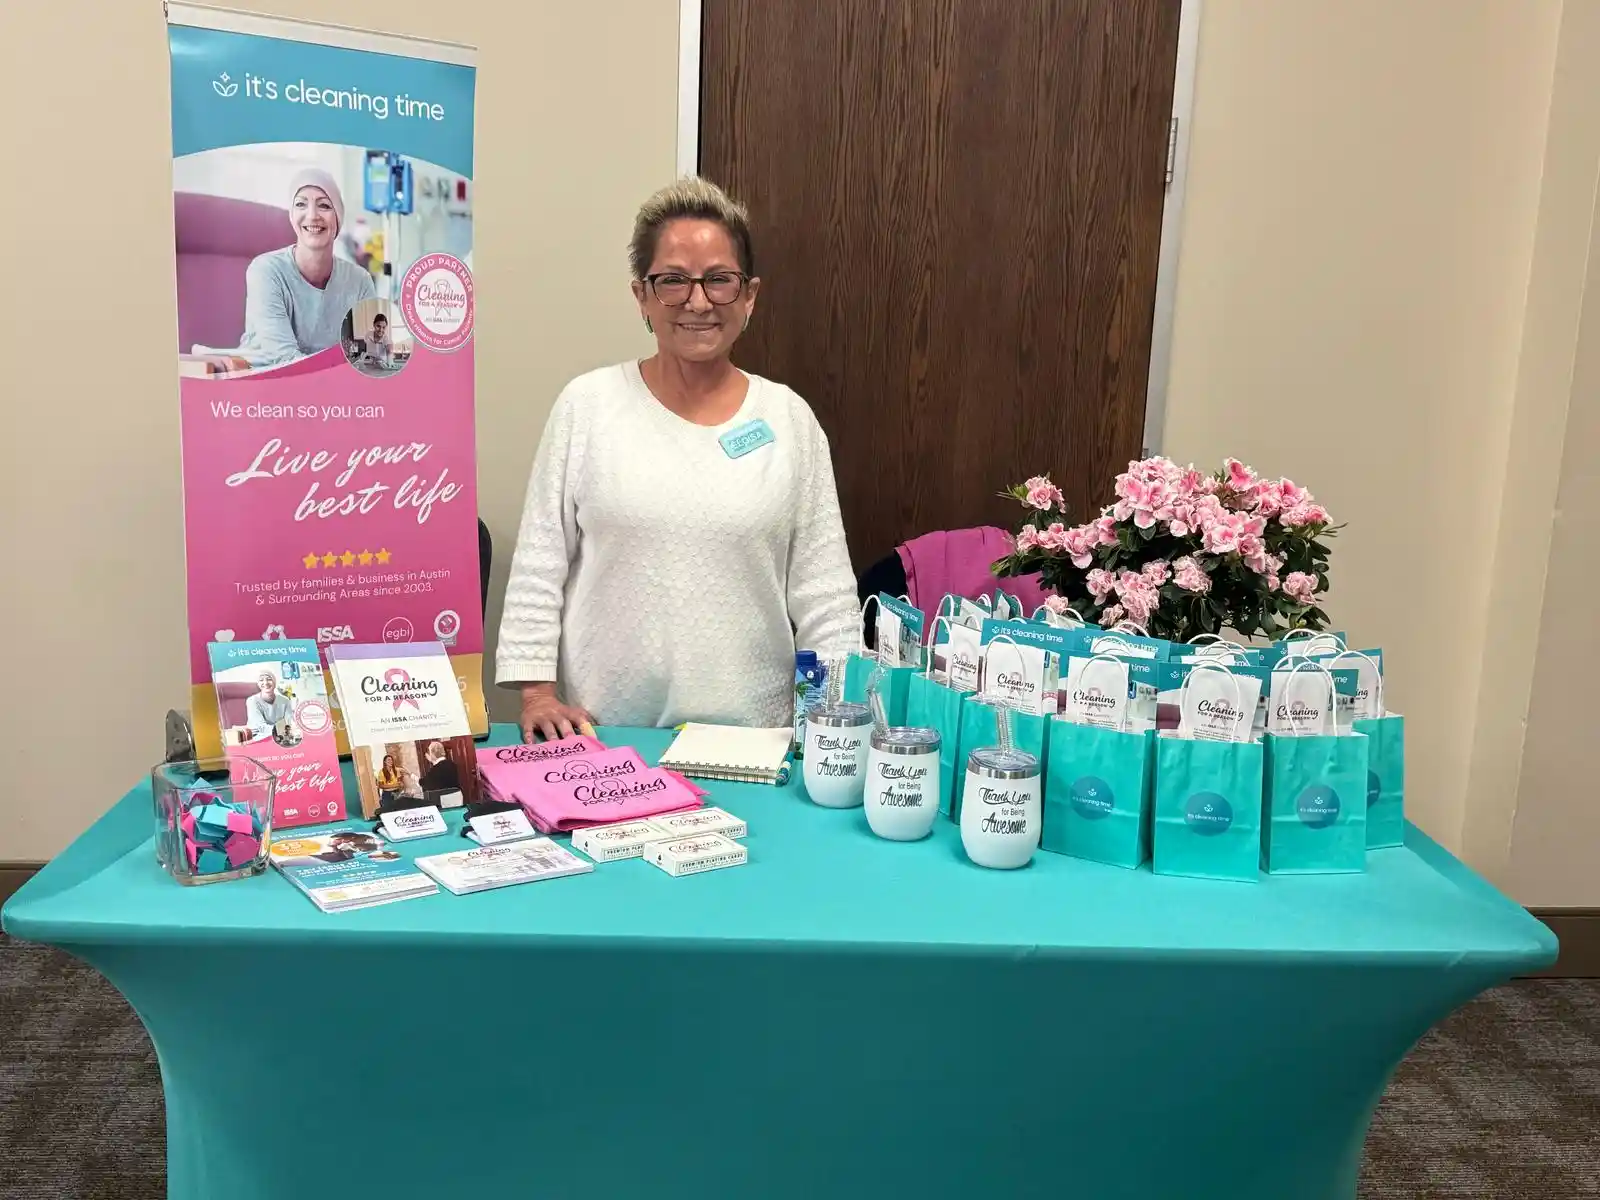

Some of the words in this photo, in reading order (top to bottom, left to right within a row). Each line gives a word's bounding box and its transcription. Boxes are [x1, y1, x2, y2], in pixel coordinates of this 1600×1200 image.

[245, 72, 278, 99] it's
[284, 79, 389, 119] cleaning
[395, 94, 445, 121] time
[406, 258, 436, 289] PROUD
[438, 257, 473, 292] PARTNER
[418, 284, 466, 309] Cleaning
[210, 400, 242, 418] We
[246, 401, 293, 418] clean
[297, 405, 318, 418] so
[321, 405, 351, 422] you
[355, 405, 385, 418] can
[225, 438, 338, 487] Live
[335, 442, 433, 488] your
[294, 481, 391, 522] best
[393, 468, 464, 525] life
[234, 580, 280, 593] Trusted
[284, 580, 298, 592] by
[301, 576, 344, 589] families
[347, 575, 355, 585] &
[358, 572, 405, 585] business
[407, 571, 417, 581] in
[419, 568, 451, 580] Austin
[255, 595, 265, 606] &
[268, 590, 337, 605] Surrounding
[339, 588, 371, 599] Areas
[373, 585, 401, 597] since
[403, 583, 434, 595] 2003.
[317, 625, 355, 643] ISSA
[386, 626, 411, 640] egbi
[1000, 625, 1011, 635] it's
[1011, 629, 1044, 642] cleaning
[1046, 633, 1063, 643] time
[238, 648, 250, 657] it's
[250, 646, 287, 656] cleaning
[288, 645, 307, 654] time
[1131, 663, 1150, 672] time
[361, 675, 438, 697] Cleaning
[391, 716, 408, 724] ISSA
[408, 714, 438, 723] CHARITY
[496, 742, 586, 762] Cleaning
[815, 734, 843, 750] Thank
[816, 757, 857, 777] Awesome
[841, 753, 855, 761] Being
[287, 760, 323, 781] your
[544, 759, 636, 784] Cleaning
[877, 762, 905, 779] Thank
[275, 777, 308, 794] best
[309, 770, 338, 793] life
[574, 777, 667, 802] Cleaning
[906, 782, 921, 791] Being
[880, 786, 923, 807] Awesome
[979, 787, 1010, 805] Thank
[394, 814, 435, 825] Cleaning
[1010, 808, 1025, 816] Being
[981, 812, 1027, 834] Awesome
